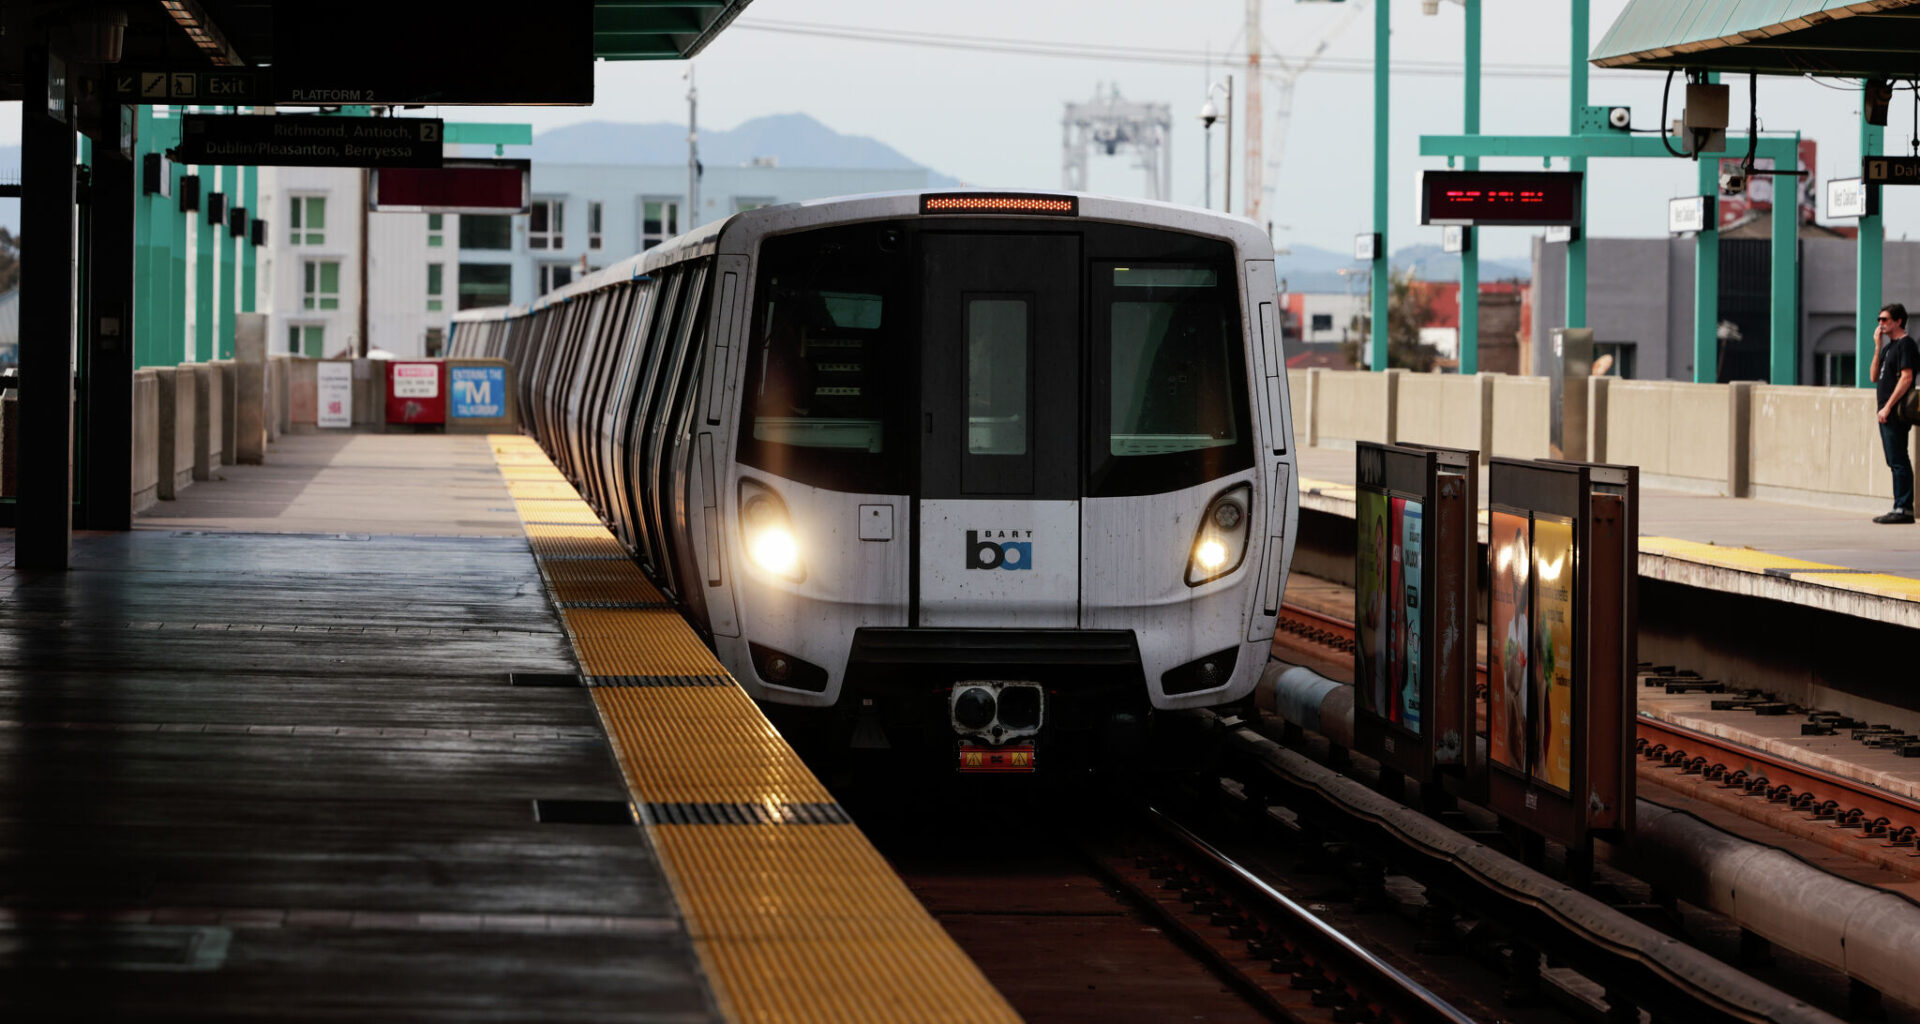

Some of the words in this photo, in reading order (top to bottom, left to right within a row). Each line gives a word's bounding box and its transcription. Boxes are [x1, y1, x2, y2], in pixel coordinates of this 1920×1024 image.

[208, 77, 245, 95] Exit
[292, 90, 361, 101] PLATFORM
[366, 90, 375, 101] 2
[273, 123, 352, 140] Richmond,
[354, 124, 413, 141] Antioch,
[423, 125, 434, 141] 2
[205, 141, 340, 159] Dublin/Pleasanton,
[345, 143, 413, 160] Berryessa
[1874, 163, 1882, 177] 1
[1894, 163, 1920, 180] Dal
[466, 381, 491, 404] M
[985, 530, 1032, 538] BART
